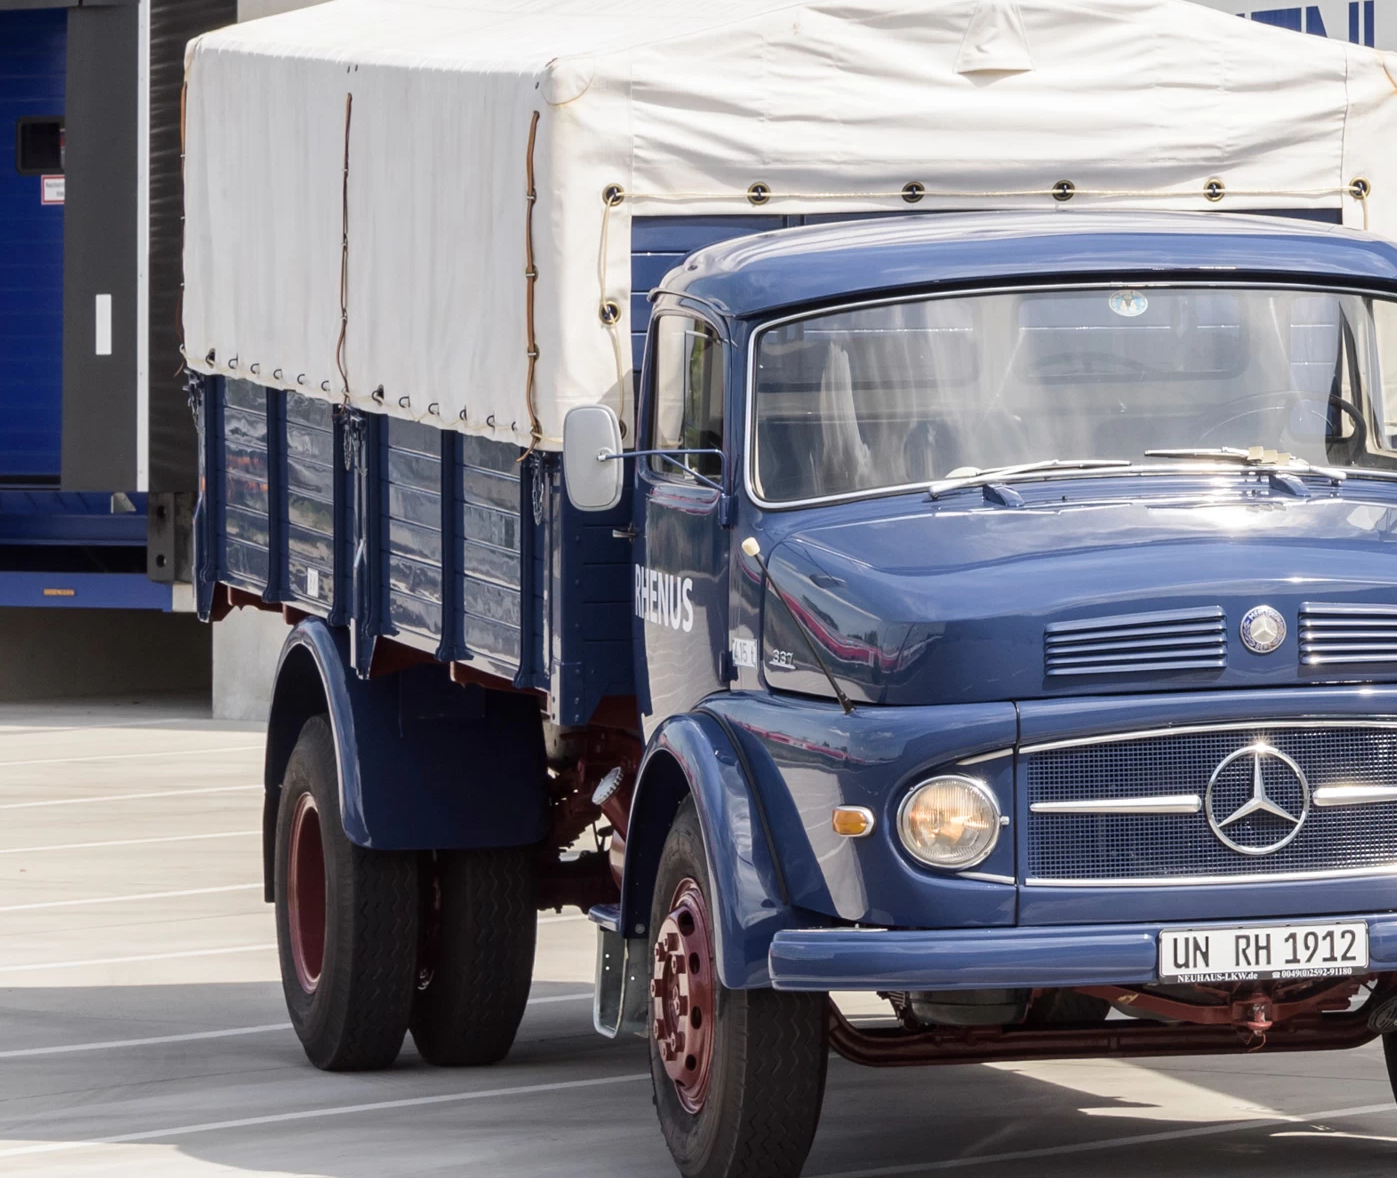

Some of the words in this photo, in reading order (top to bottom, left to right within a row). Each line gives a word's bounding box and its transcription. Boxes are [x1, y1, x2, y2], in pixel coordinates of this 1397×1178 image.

[635, 563, 694, 633] RHENUS
[1173, 936, 1210, 969] UN
[1234, 934, 1271, 966] RH
[1284, 929, 1356, 964] 1912
[1177, 973, 1258, 983] NEUHAUS-LKW.de
[1281, 967, 1353, 979] 0049(0)2592-91180
